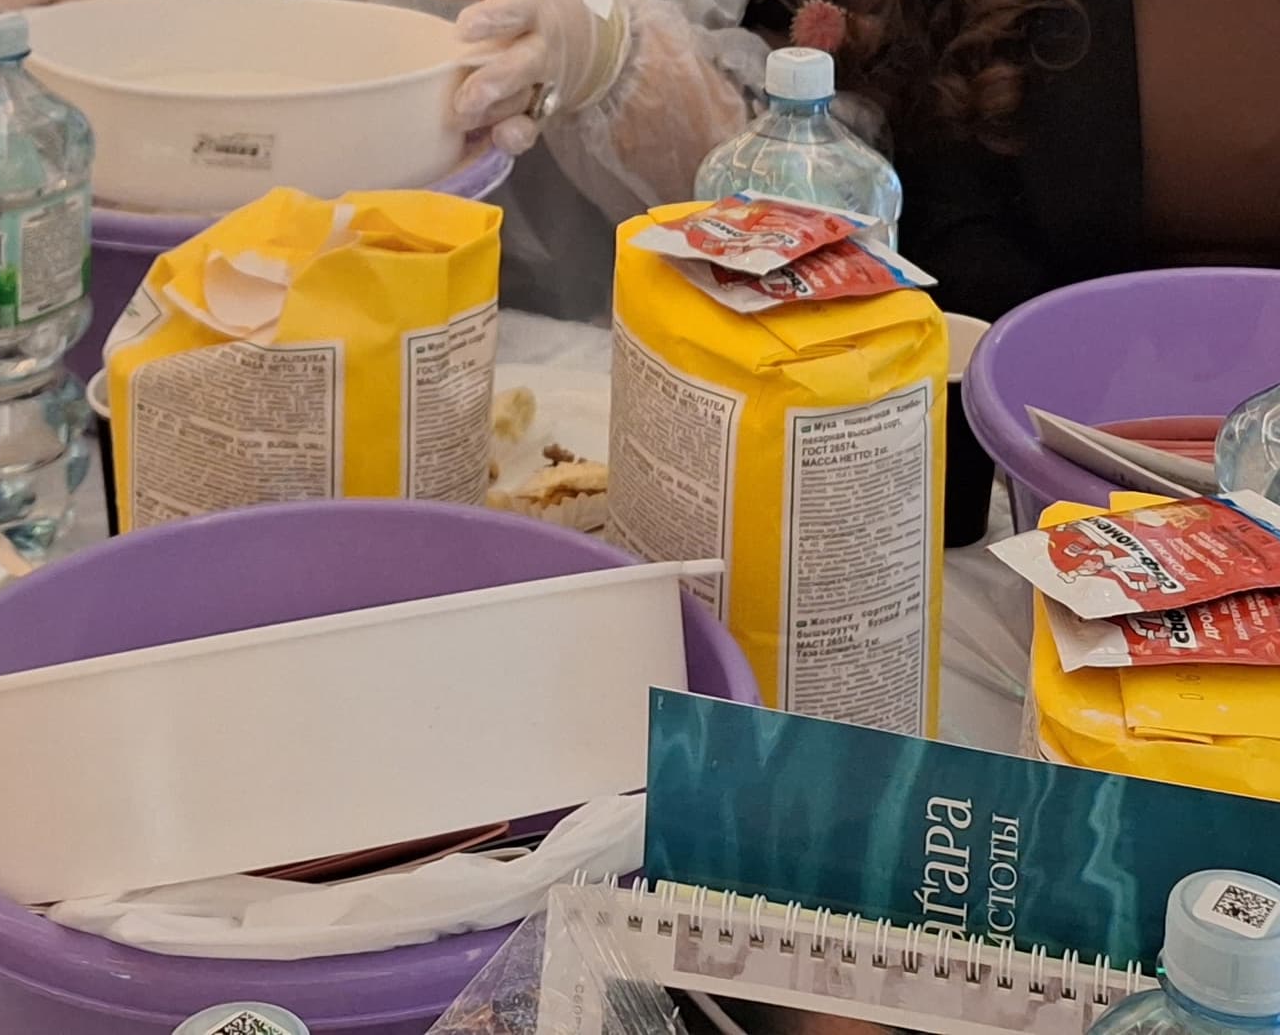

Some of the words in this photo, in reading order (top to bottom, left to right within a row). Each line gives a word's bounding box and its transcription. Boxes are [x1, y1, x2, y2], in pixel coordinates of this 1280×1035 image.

[814, 421, 837, 432] Мука
[802, 443, 829, 457] ГОСТ
[801, 455, 838, 468] МАССА
[810, 613, 853, 626] Жогорку
[796, 638, 825, 649] МАСТ
